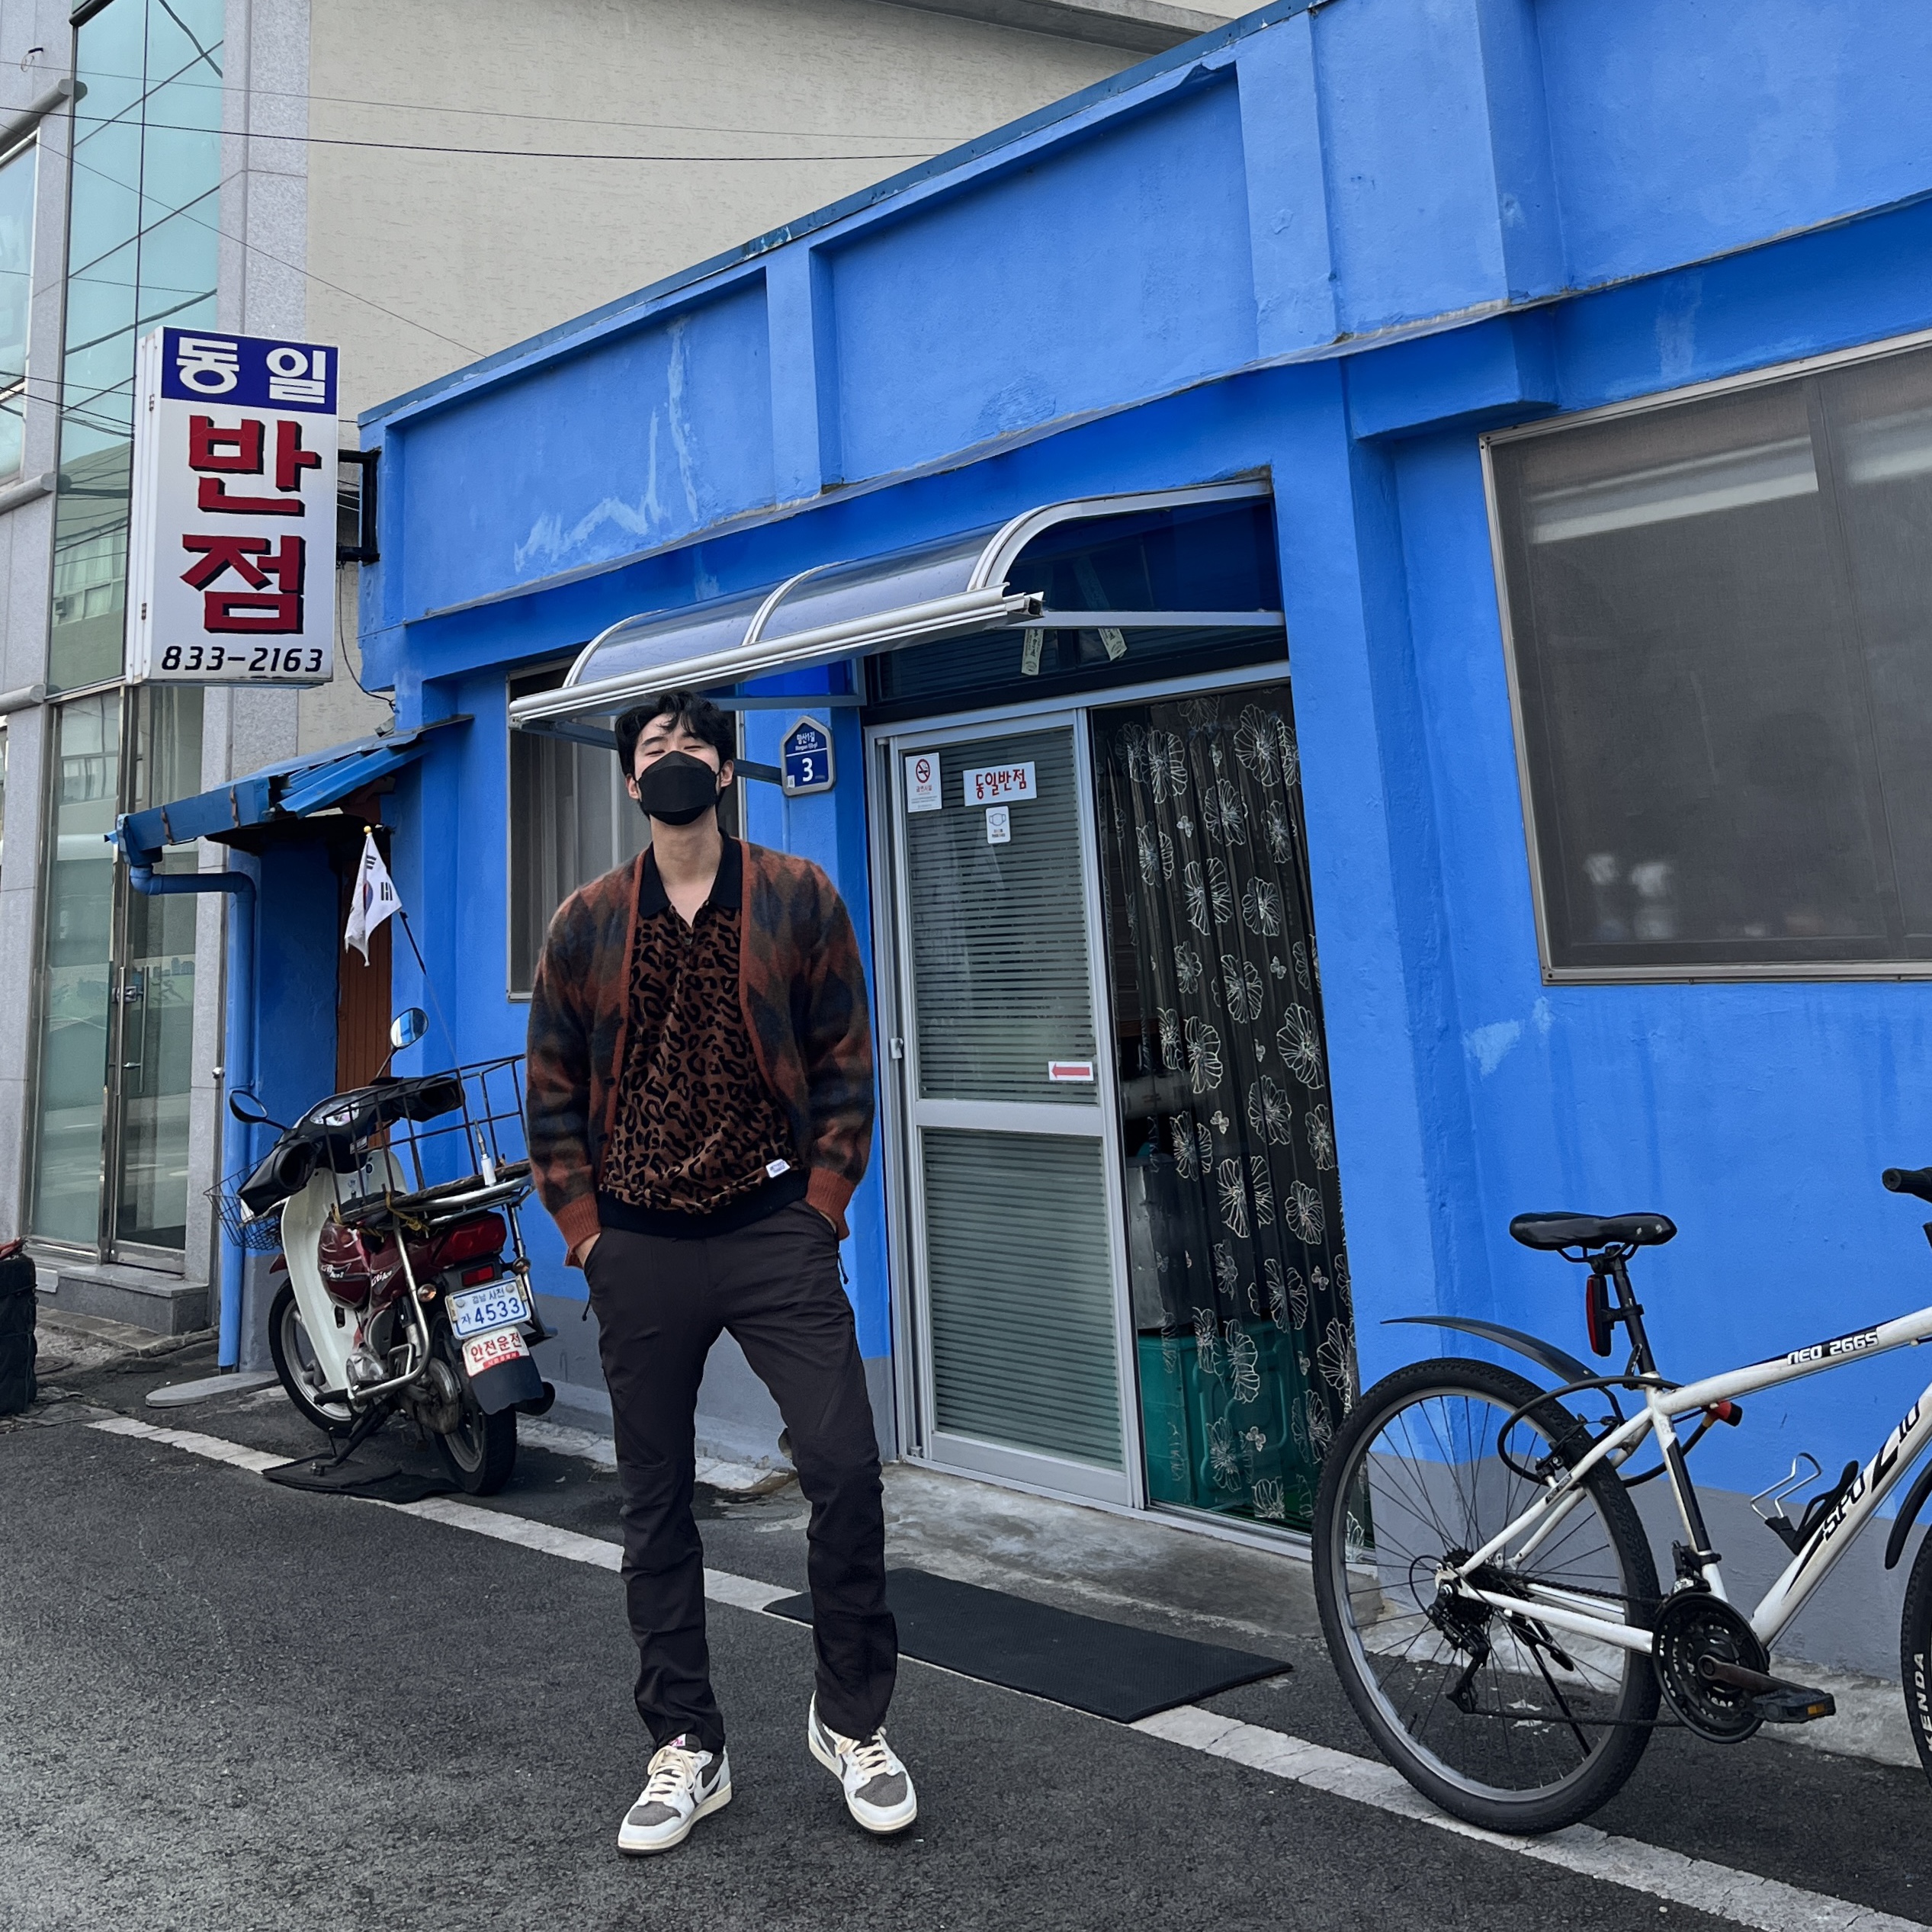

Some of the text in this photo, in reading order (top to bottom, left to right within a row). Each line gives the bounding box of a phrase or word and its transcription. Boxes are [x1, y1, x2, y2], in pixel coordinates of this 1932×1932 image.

[162, 645, 323, 673] 833-2163
[801, 757, 814, 782] 3
[975, 769, 1027, 800] 동일반점
[475, 1297, 520, 1324] 4533
[470, 1332, 523, 1363] 안전운전
